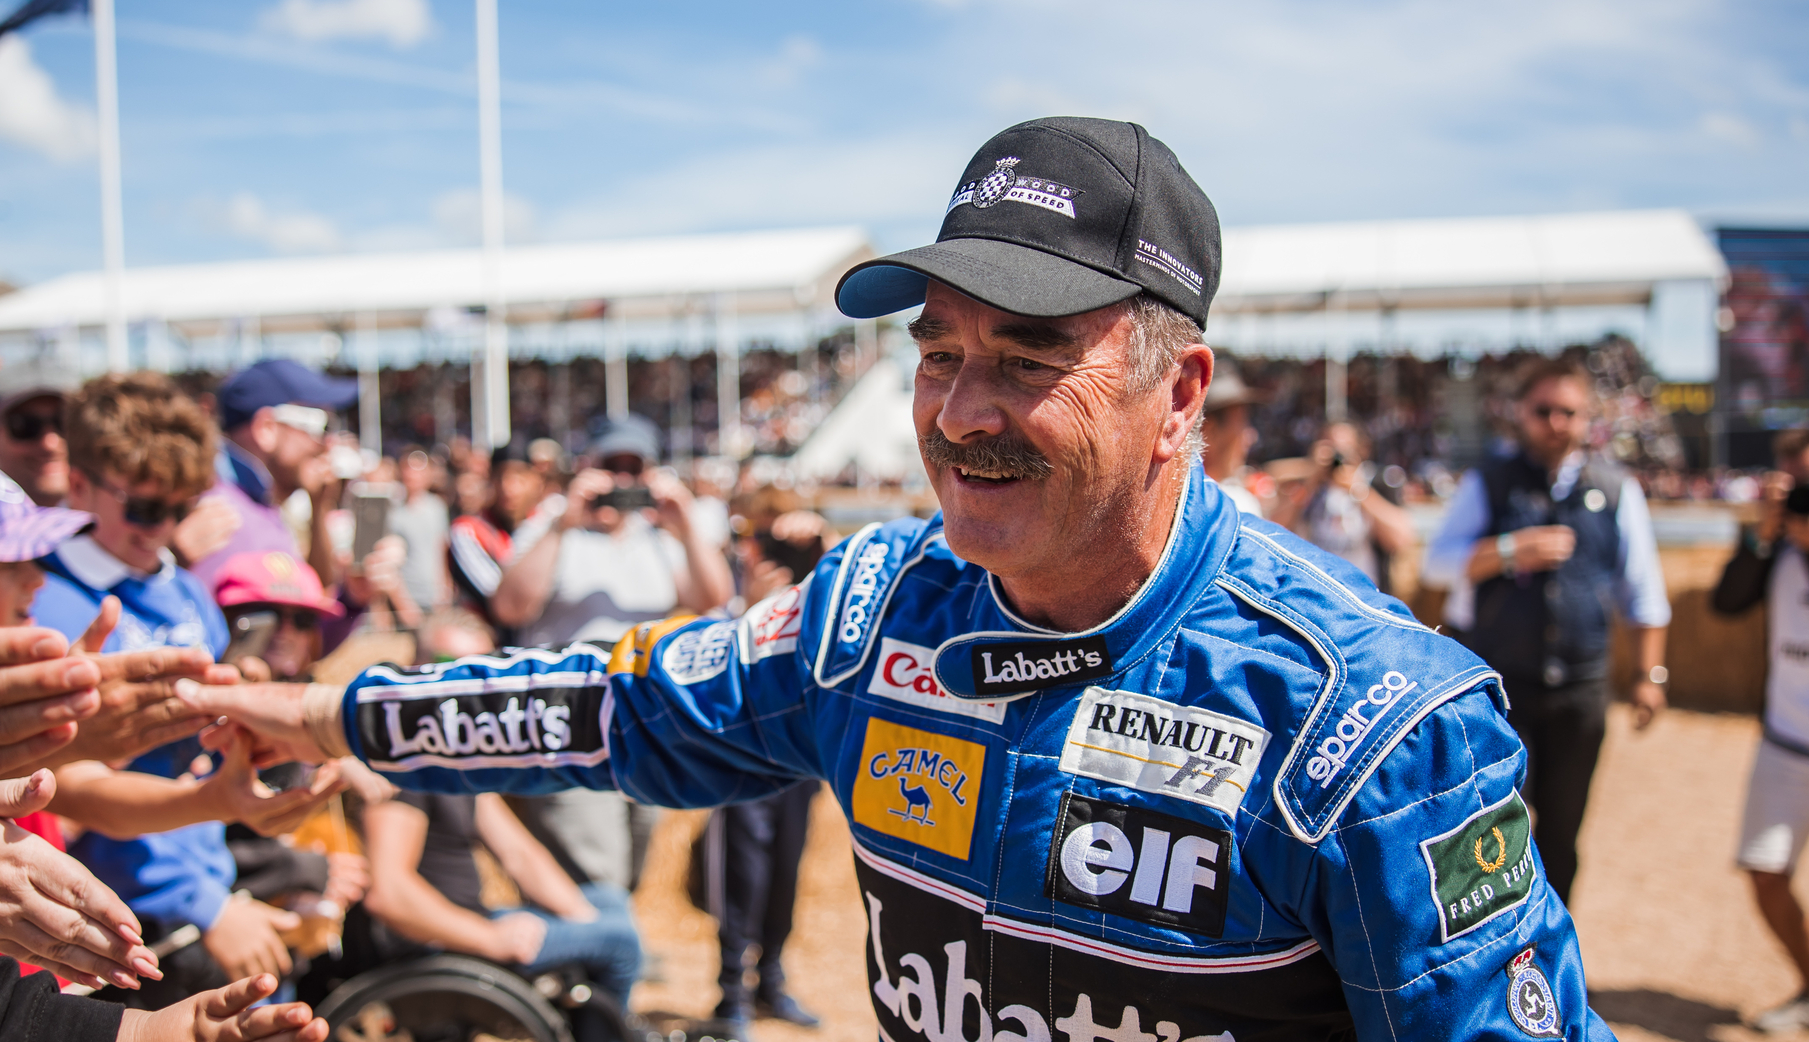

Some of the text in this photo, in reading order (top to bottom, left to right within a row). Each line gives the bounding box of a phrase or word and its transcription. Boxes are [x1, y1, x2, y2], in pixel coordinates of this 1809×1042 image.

[1018, 179, 1070, 197] WOOD
[1027, 193, 1064, 209] SPEED
[1138, 239, 1203, 285] THE INNOVATORS
[840, 542, 890, 644] sparco
[982, 648, 1103, 685] Labatt's
[382, 697, 571, 757] Labatt's
[1088, 702, 1254, 767] RENAULT
[1306, 671, 1408, 781] sparco
[869, 748, 967, 806] CAMEL
[1164, 755, 1236, 798] F1
[1060, 822, 1220, 914] elf
[1449, 884, 1494, 919] FRED
